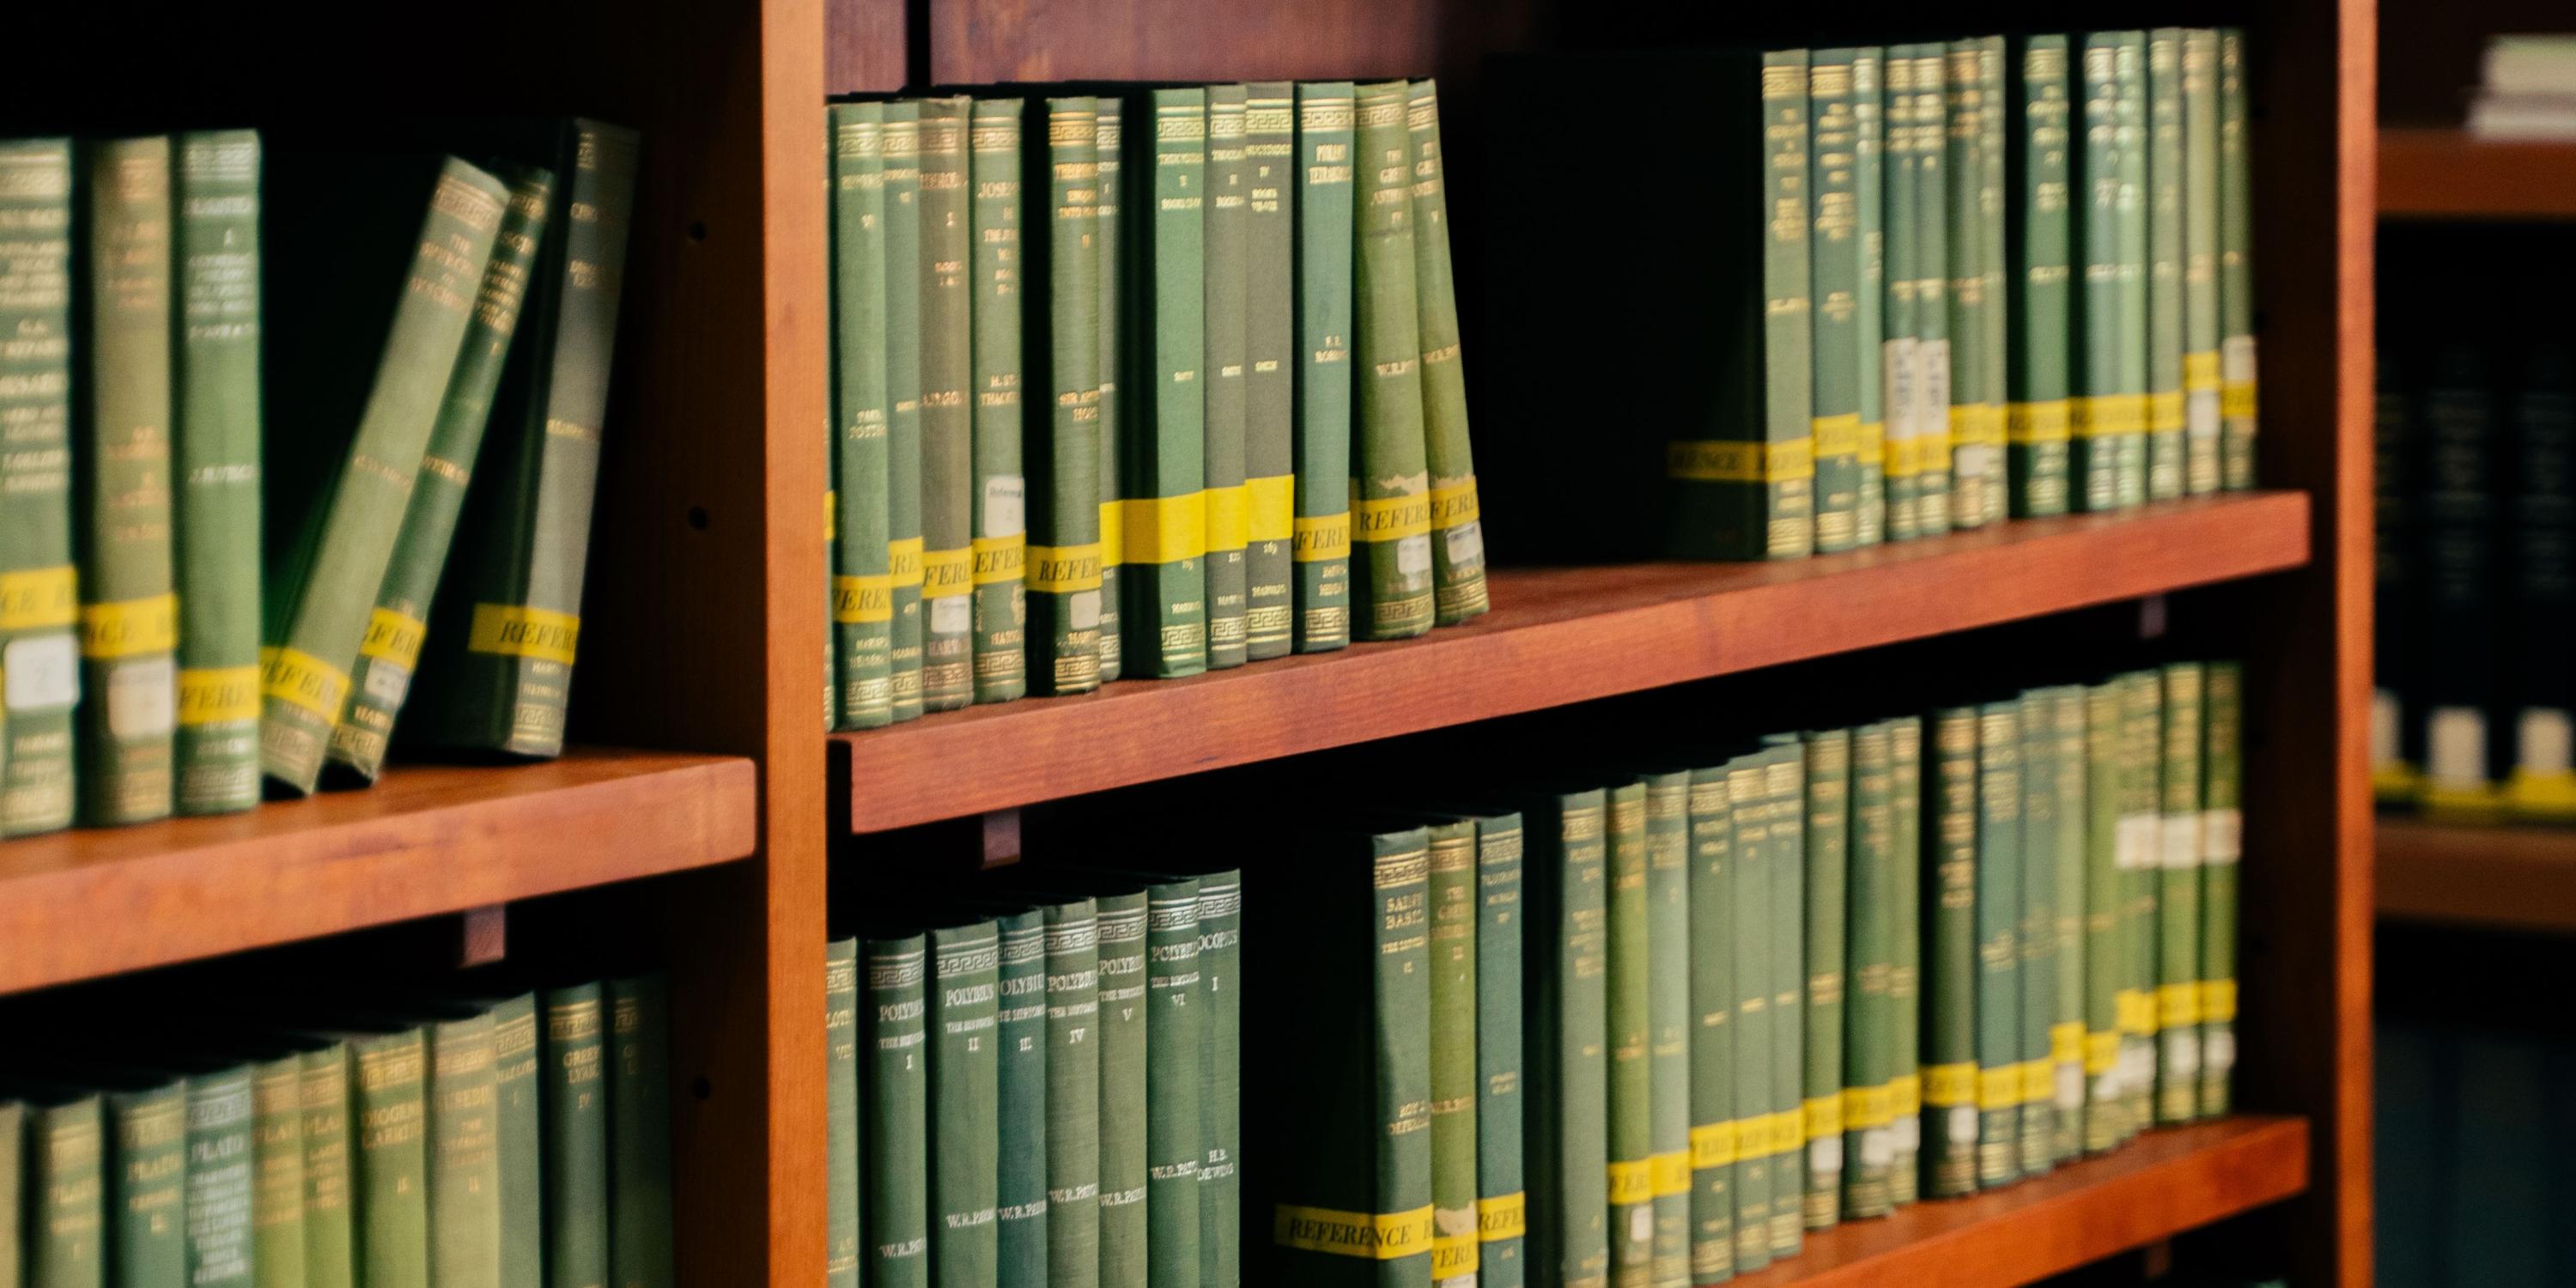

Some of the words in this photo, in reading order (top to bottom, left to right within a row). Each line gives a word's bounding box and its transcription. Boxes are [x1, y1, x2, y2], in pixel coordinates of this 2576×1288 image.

[1385, 892, 1425, 914] SAINT
[1385, 908, 1425, 931] BASIL
[1212, 975, 1219, 992] I
[945, 982, 994, 1007] POLYBIUS
[1122, 1007, 1133, 1022] V
[968, 1036, 980, 1052] II
[1069, 1028, 1086, 1044] IV
[906, 1054, 914, 1070] I
[1290, 1218, 1413, 1248] REFERENCE
